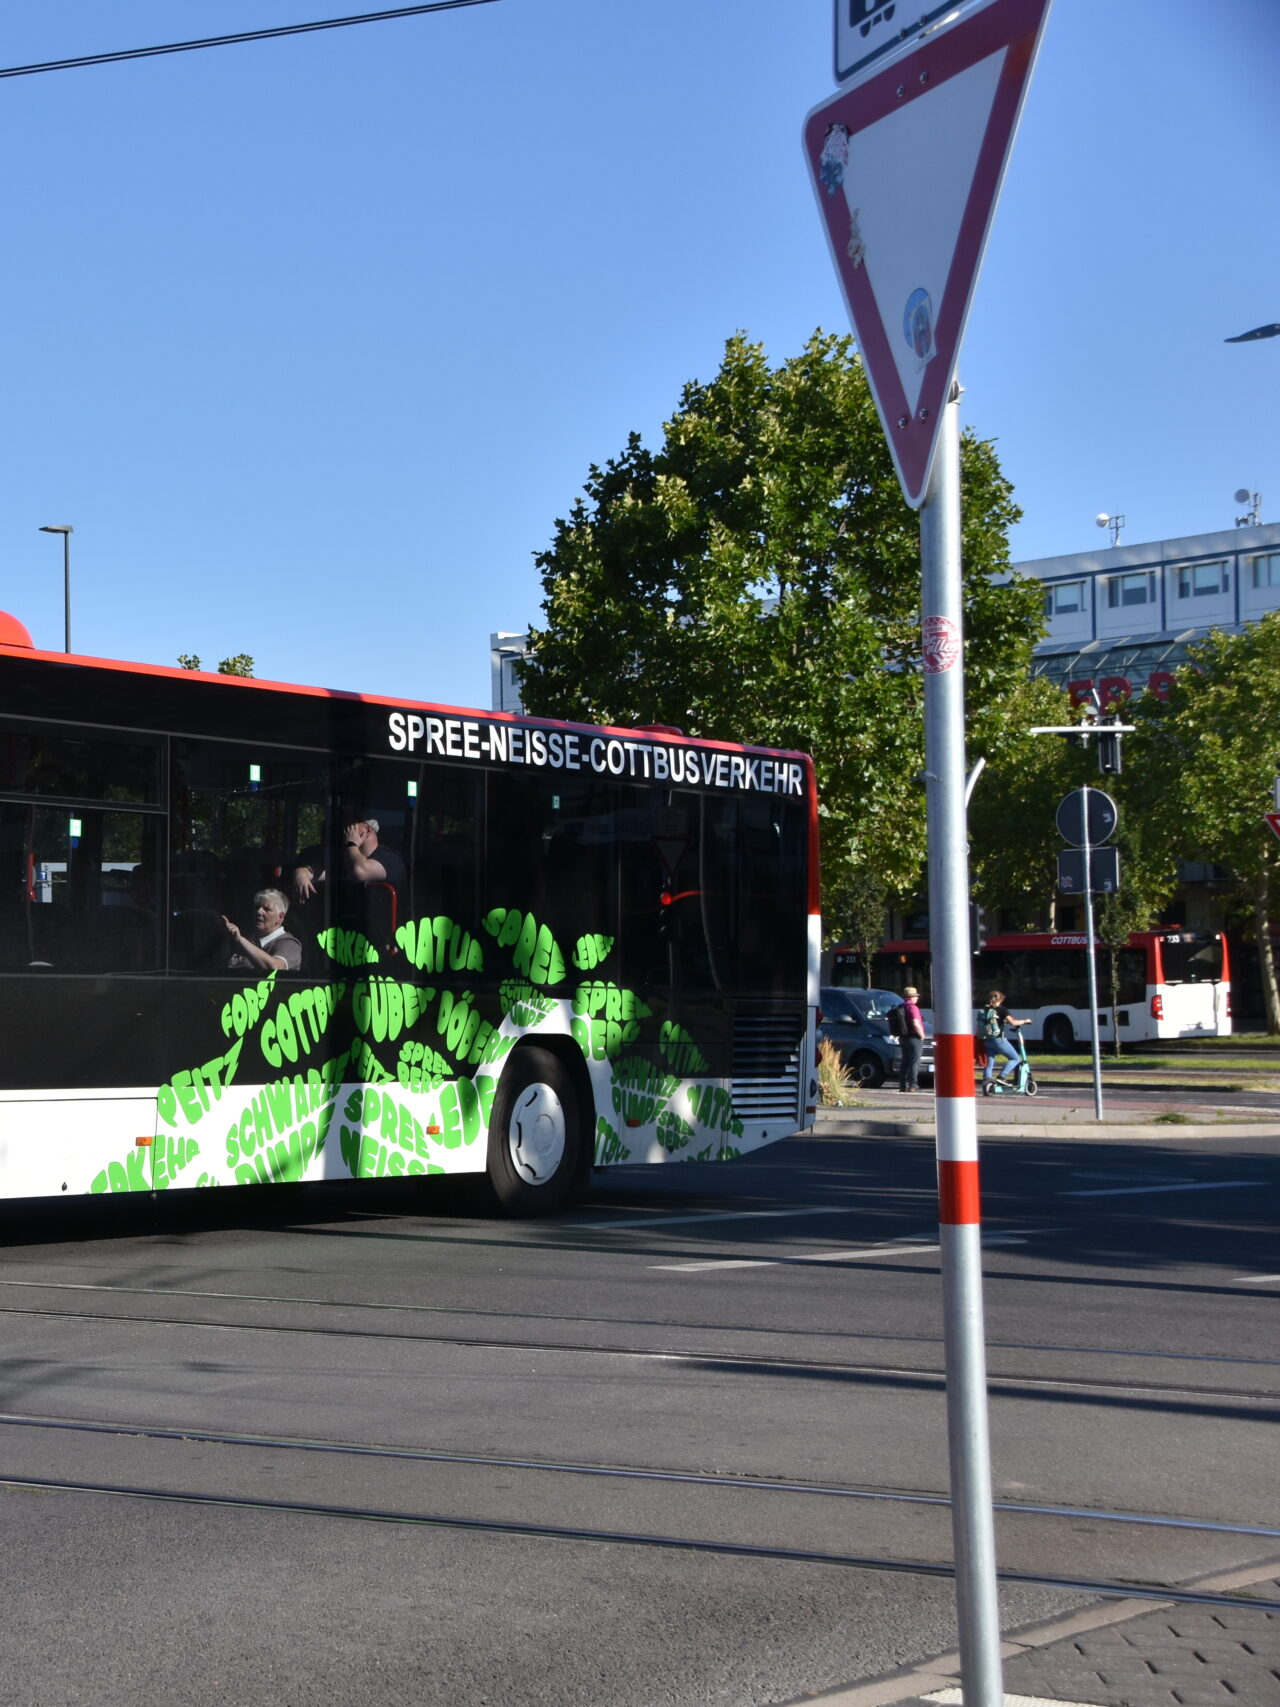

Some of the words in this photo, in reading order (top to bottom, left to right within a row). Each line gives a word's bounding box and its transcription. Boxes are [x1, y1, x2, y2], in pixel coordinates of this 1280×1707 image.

[388, 711, 803, 796] SPREE-NEISSE-COTTBUSVERKEHR
[316, 927, 380, 968] VERKEHR
[395, 915, 484, 974] NATUR
[482, 907, 567, 986] SPREE
[572, 933, 615, 971] LEBEN
[221, 968, 278, 1038] FORST
[260, 977, 346, 1068] COTTBUS
[352, 974, 437, 1043] GUBEN
[436, 989, 519, 1065] DÖBERN
[350, 1036, 396, 1086] PEITZ
[570, 1017, 641, 1062] BERG
[157, 1036, 244, 1128] PEITZ
[225, 1050, 351, 1169] SCHWARZE
[396, 1061, 445, 1095] BERG
[343, 1087, 431, 1160] SPREE
[84, 1134, 201, 1194] ERKEHR
